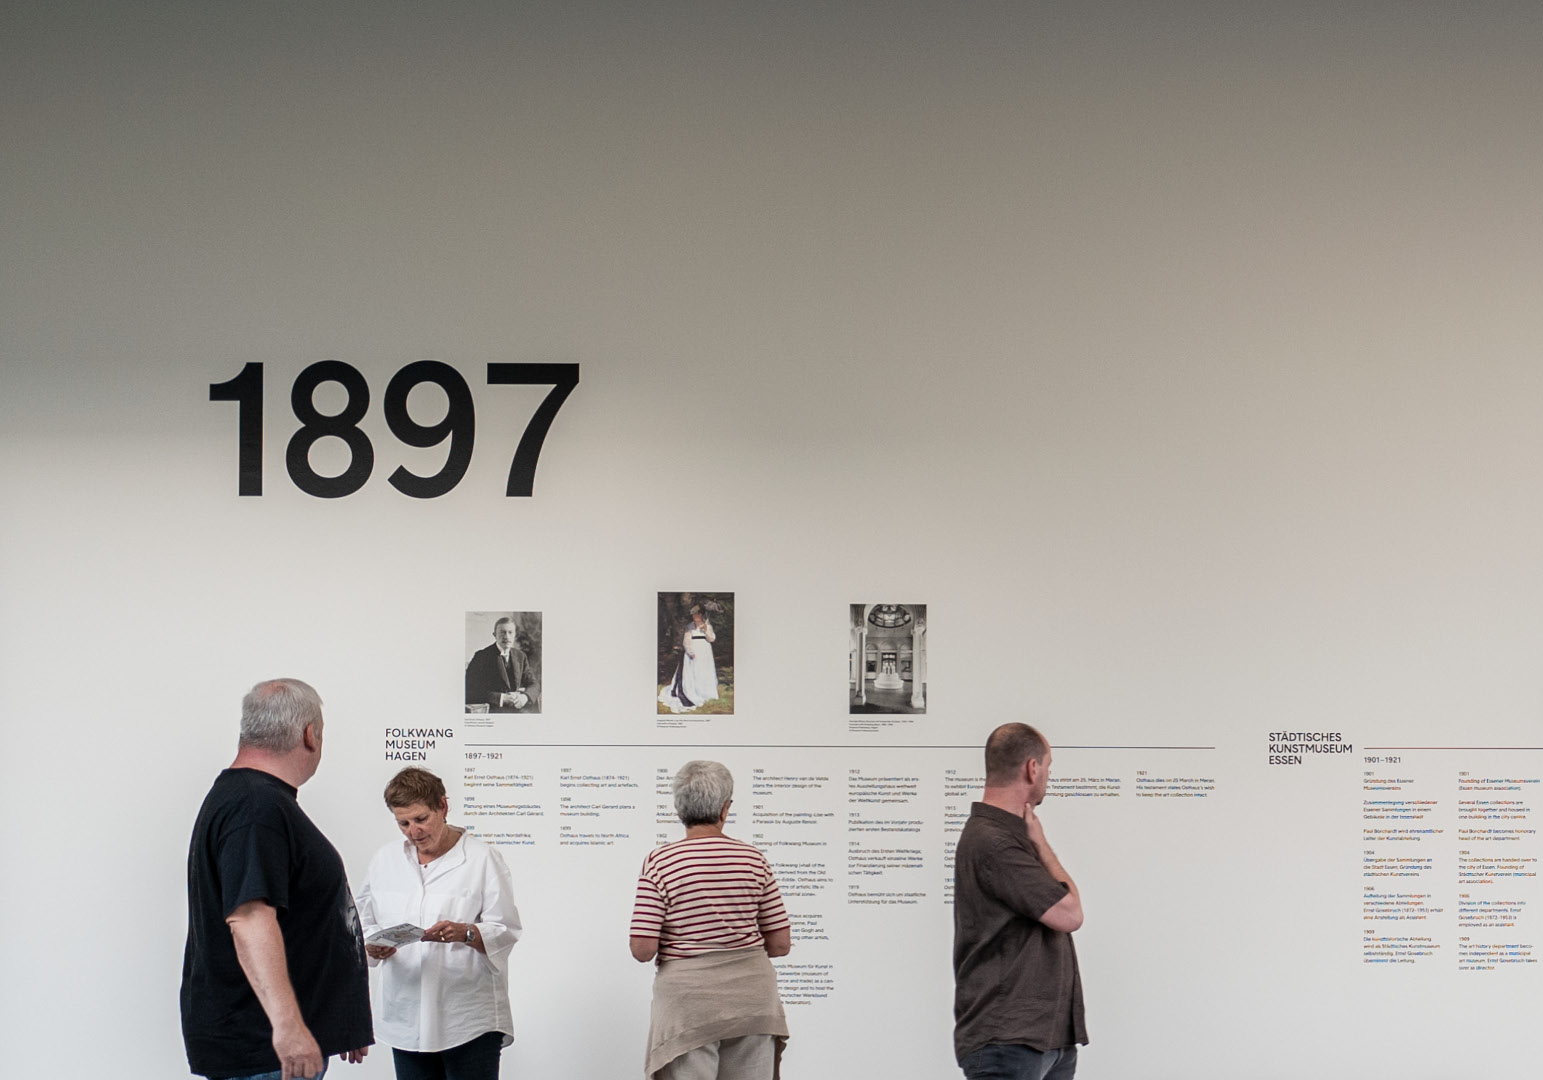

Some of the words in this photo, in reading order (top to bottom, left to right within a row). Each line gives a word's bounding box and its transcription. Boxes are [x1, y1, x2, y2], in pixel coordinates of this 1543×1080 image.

[209, 359, 580, 499] 1897
[385, 728, 454, 738] FOLKWANG
[1268, 731, 1342, 742] STÄDTISCHES
[385, 740, 436, 750] MUSEUM
[1268, 743, 1353, 754] KUNSTMUSEUM
[385, 751, 427, 761] HAGEN
[1268, 755, 1302, 765] ESSEN
